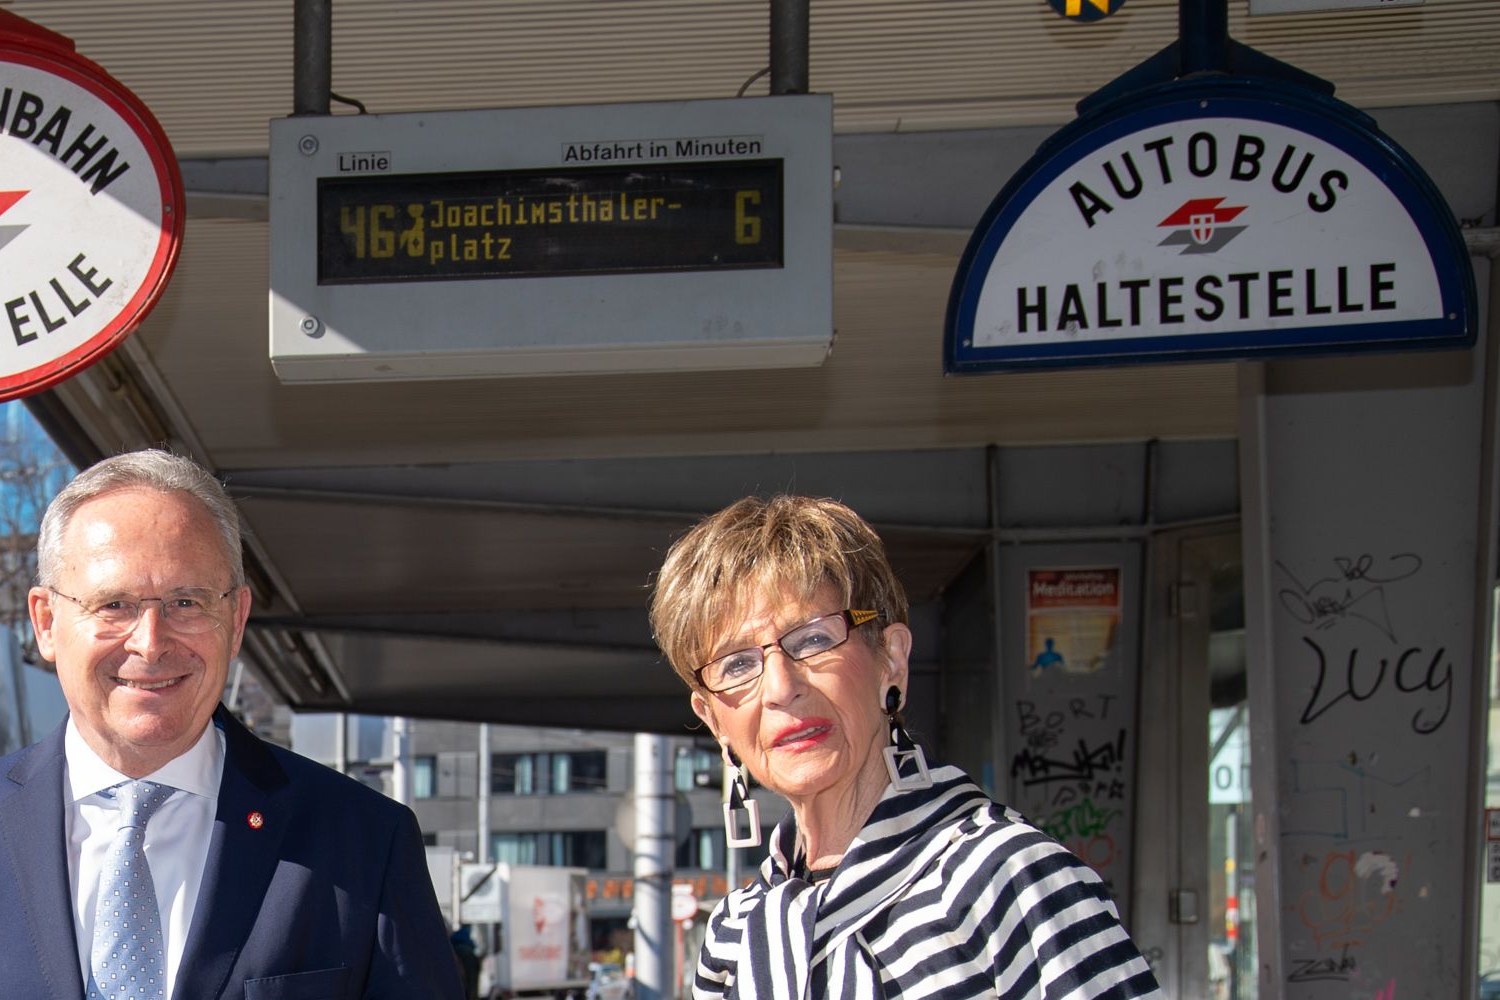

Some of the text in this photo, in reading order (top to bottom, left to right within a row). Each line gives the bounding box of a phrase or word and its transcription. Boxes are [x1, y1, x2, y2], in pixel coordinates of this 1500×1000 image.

[338, 153, 389, 172] Linie
[564, 137, 762, 162] Abfahrt in Minuten
[1068, 131, 1349, 228] AUTOBUS
[340, 204, 396, 260] 46
[430, 190, 762, 245] Joachimsthaler- 6
[430, 234, 513, 266] platz
[1016, 262, 1398, 334] HALTESTELLE
[1032, 581, 1116, 598] Meditation
